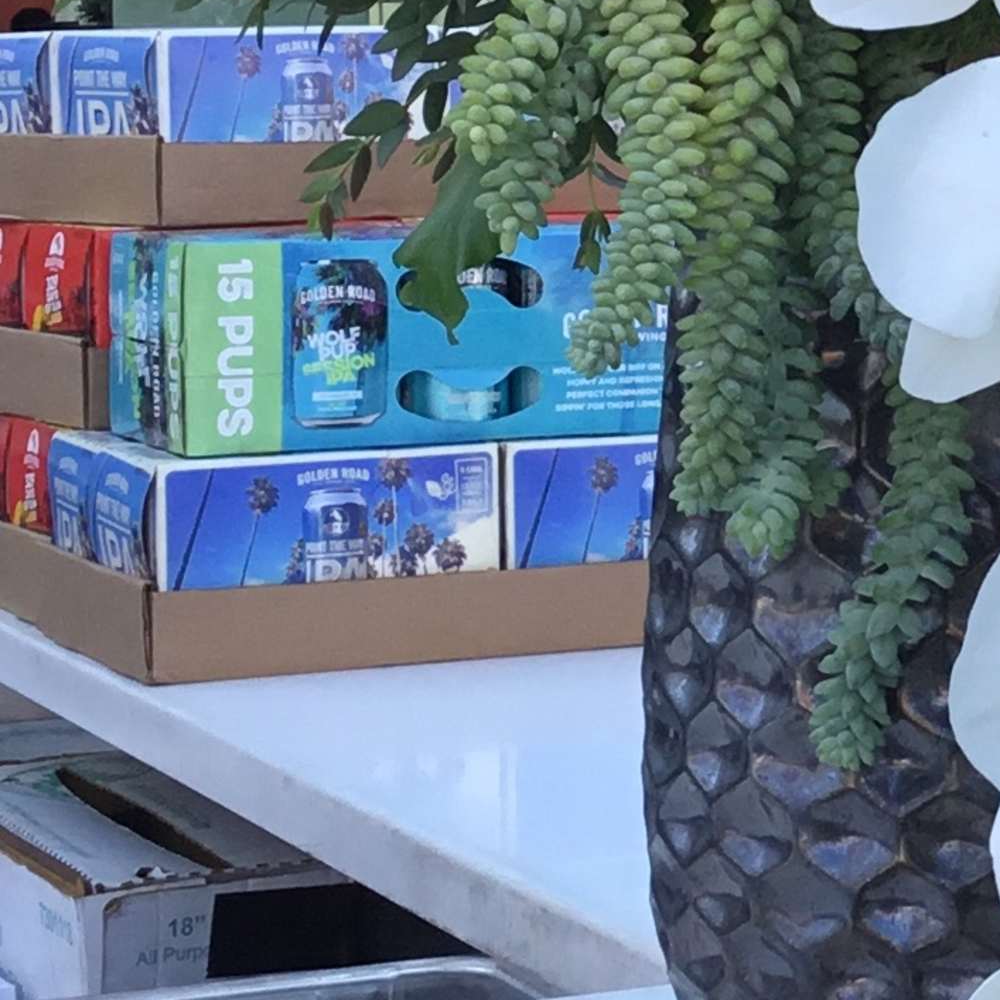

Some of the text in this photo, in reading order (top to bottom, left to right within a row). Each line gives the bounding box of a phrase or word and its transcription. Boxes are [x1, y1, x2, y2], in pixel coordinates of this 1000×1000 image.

[300, 284, 377, 305] GOLDEN ROAD
[217, 258, 254, 437] 15 PUPS
[306, 326, 362, 350] WOLF
[319, 342, 357, 362] PUP
[297, 466, 370, 486] GOLDEN ROAD
